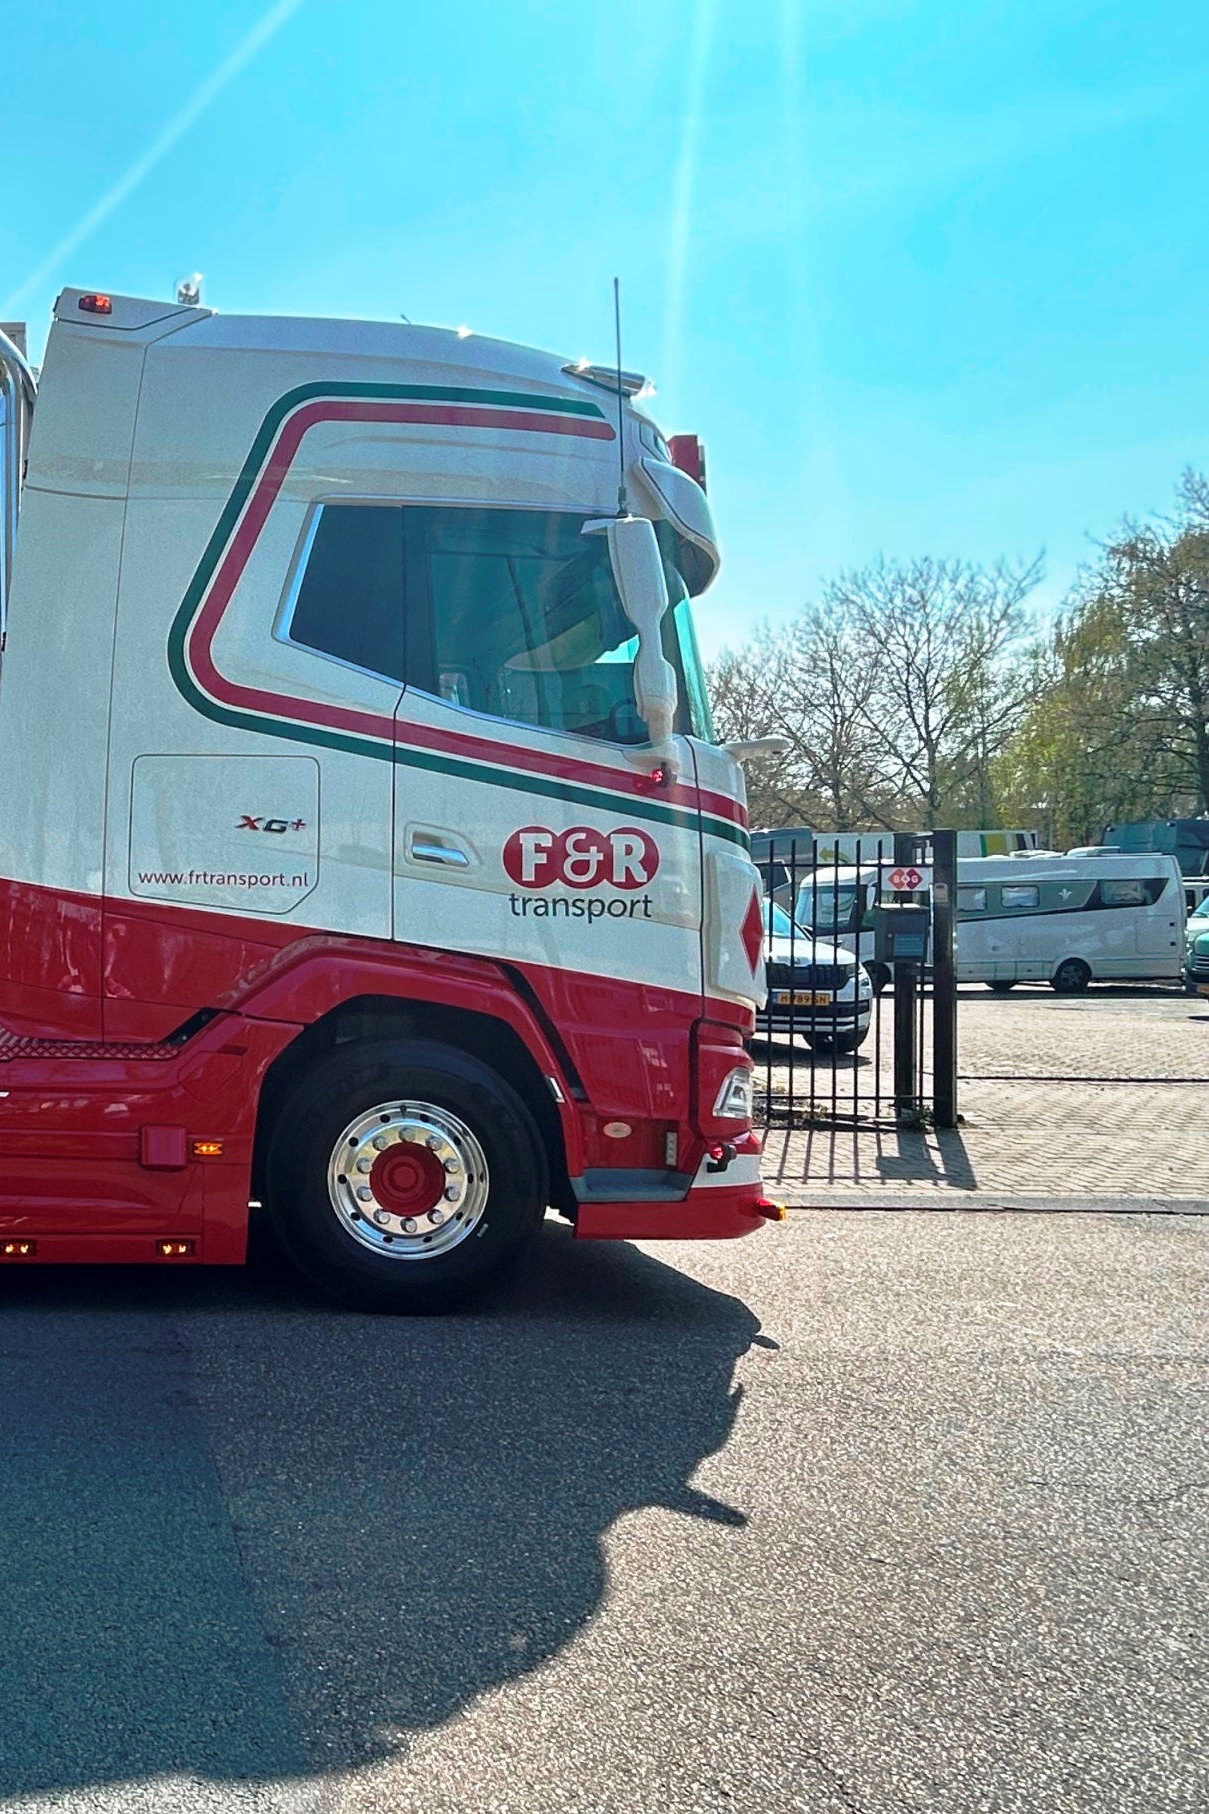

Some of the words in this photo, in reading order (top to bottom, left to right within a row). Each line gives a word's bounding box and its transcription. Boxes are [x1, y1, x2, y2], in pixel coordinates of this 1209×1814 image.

[235, 815, 306, 834] XG+
[518, 832, 648, 883] F&R
[138, 870, 309, 889] www.frtransport.nl
[509, 893, 653, 924] transport
